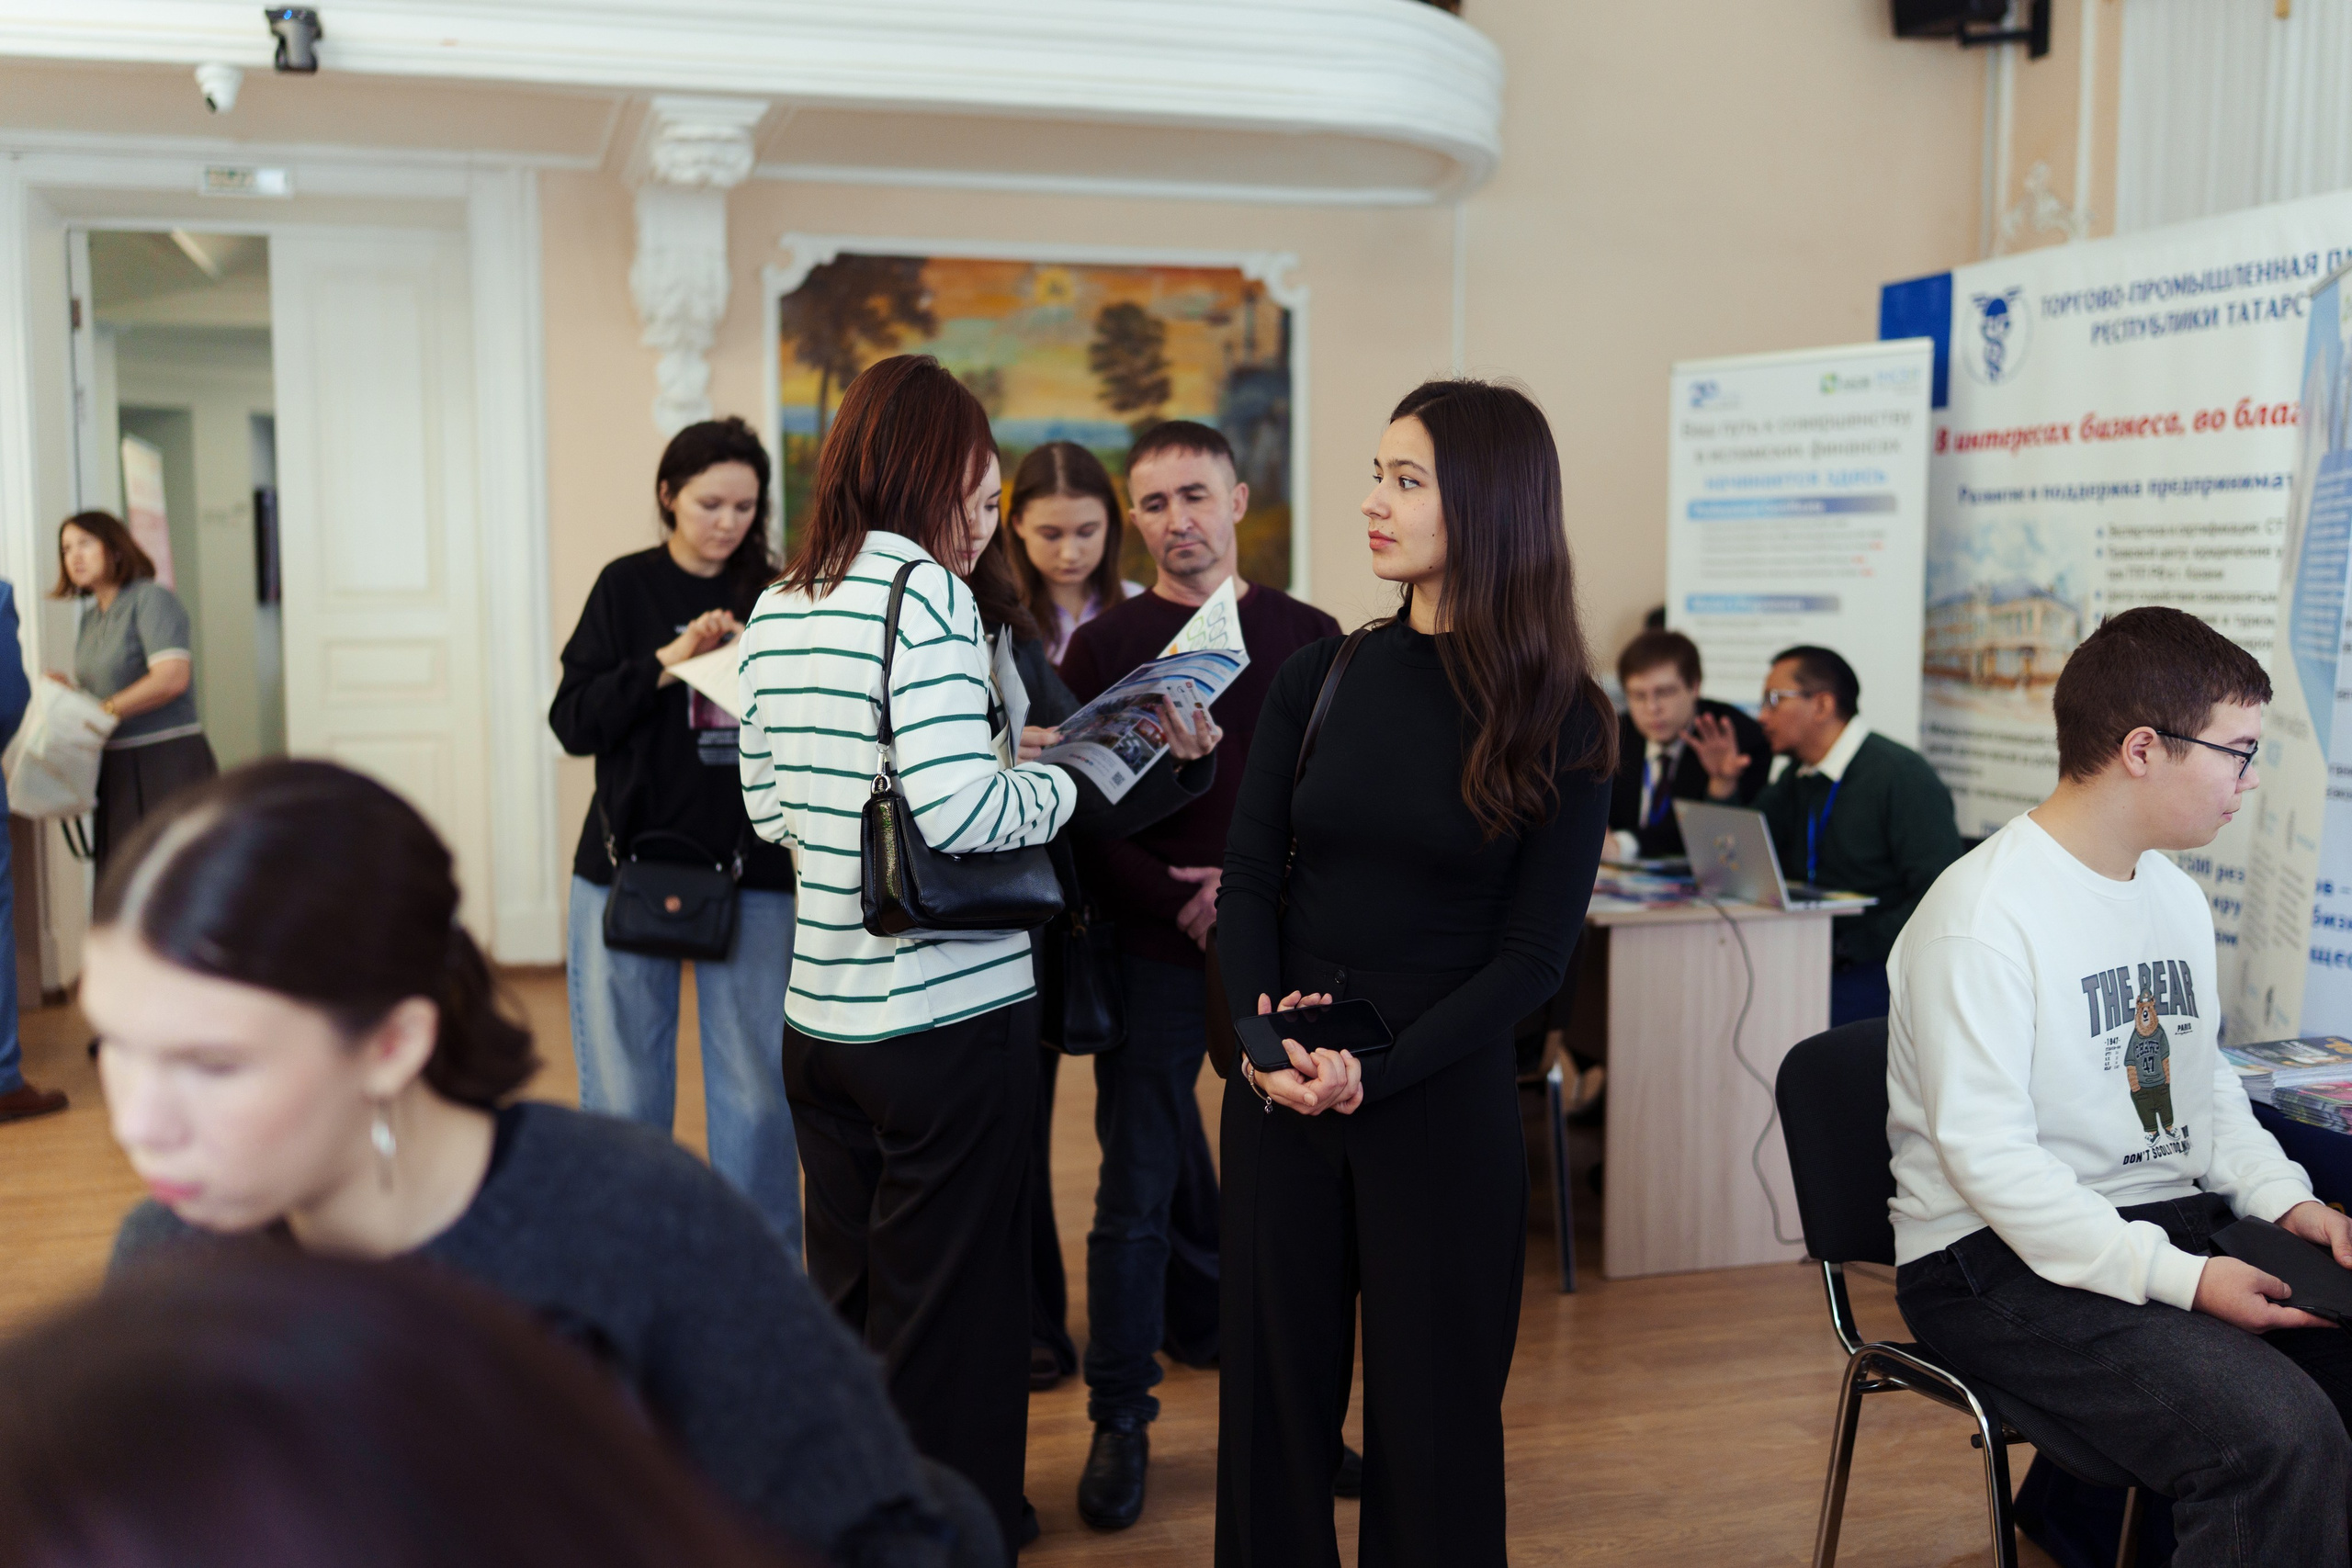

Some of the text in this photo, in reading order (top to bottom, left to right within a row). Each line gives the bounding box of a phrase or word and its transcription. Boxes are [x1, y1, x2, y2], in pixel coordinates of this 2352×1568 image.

[2091, 305, 2220, 345] РЕСПУБЛИКИ
[1953, 422, 2074, 457] интересах
[2192, 408, 2227, 434] во
[2081, 960, 2199, 1038] THE BEAR
[2122, 1149, 2150, 1166] DON'T
